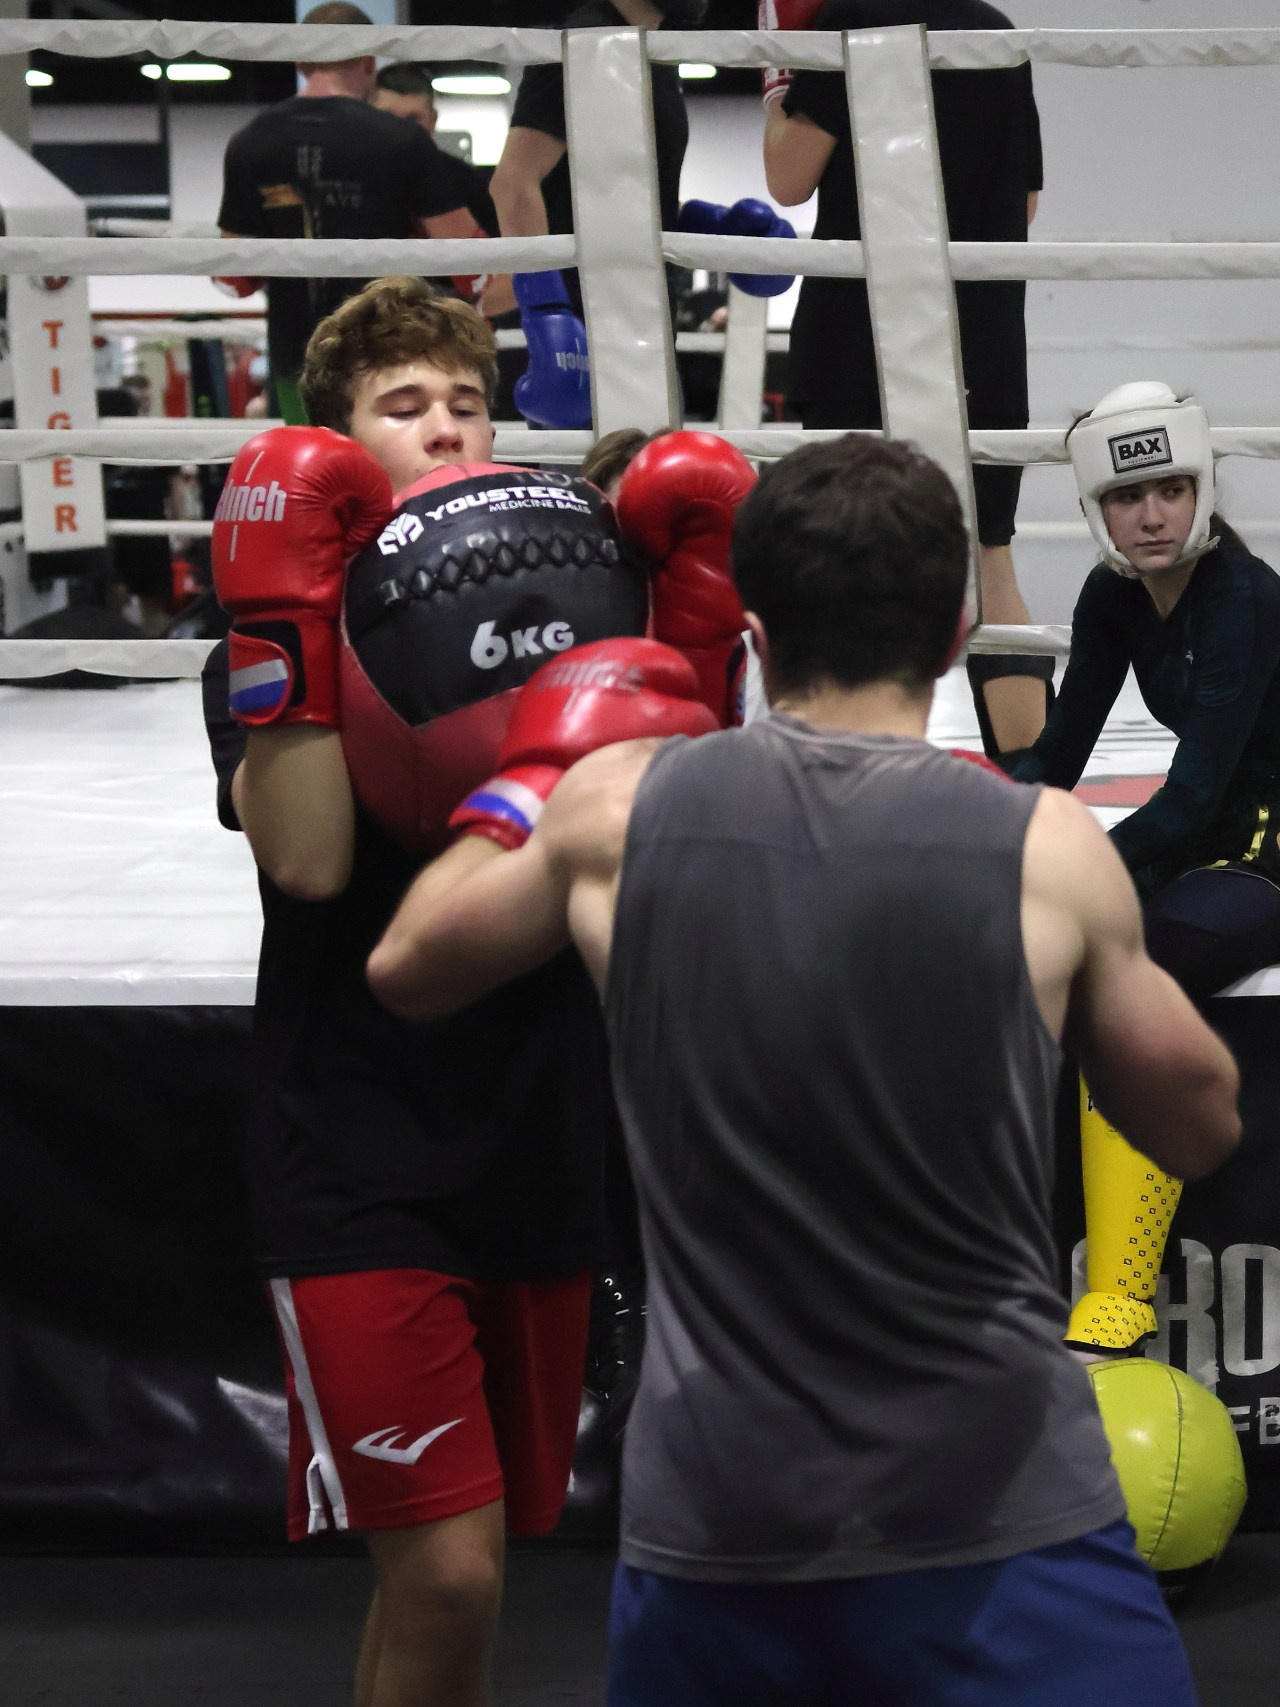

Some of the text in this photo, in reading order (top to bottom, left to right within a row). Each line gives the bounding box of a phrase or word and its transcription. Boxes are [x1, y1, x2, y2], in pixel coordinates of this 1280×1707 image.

[42, 320, 78, 533] TIGER
[1117, 437, 1162, 460] BAX
[425, 486, 588, 521] YOUSTEEL
[489, 499, 592, 514] MEDICINE BALLS
